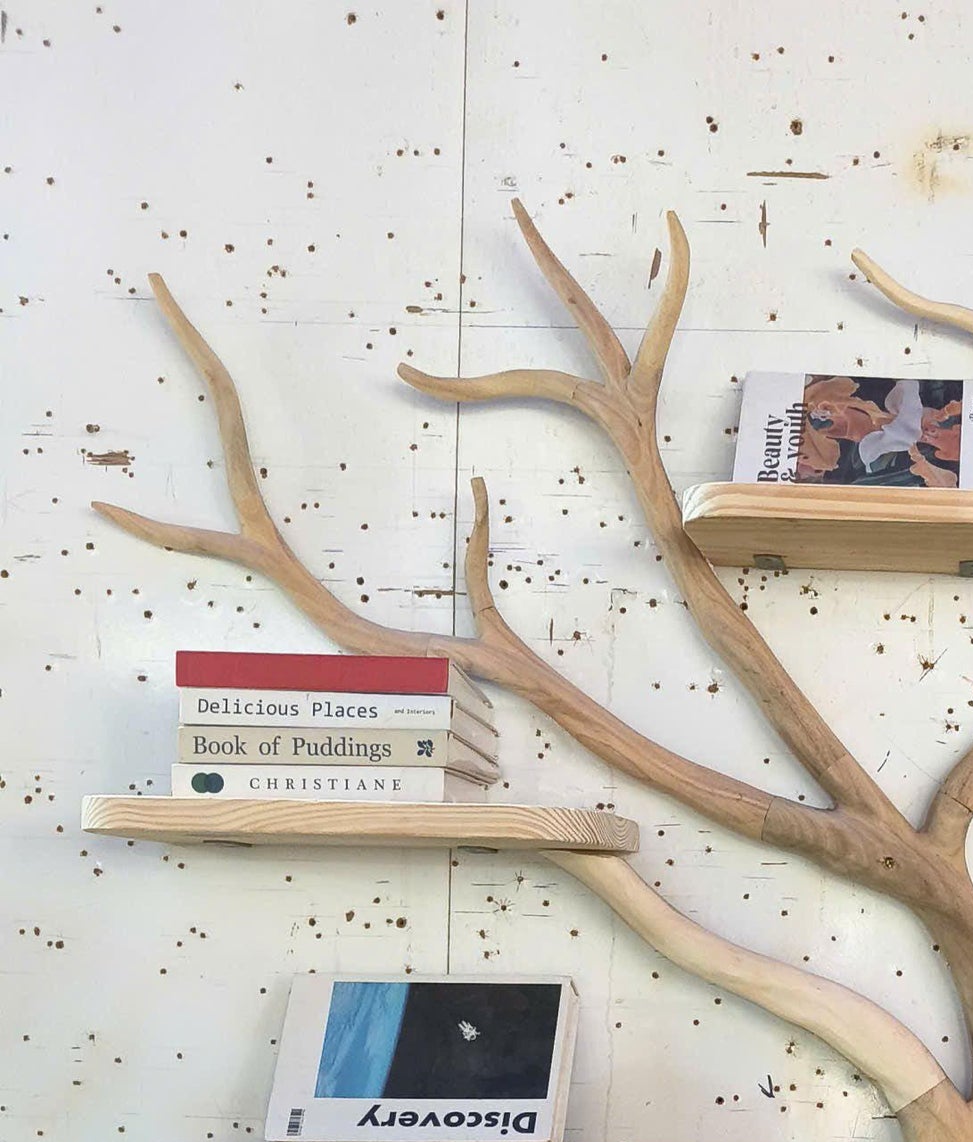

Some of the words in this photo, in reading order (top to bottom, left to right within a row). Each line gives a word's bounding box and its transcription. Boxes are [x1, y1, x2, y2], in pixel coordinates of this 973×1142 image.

[785, 402, 808, 460] youth
[757, 414, 789, 482] Beauty
[780, 467, 799, 483] &
[197, 698, 299, 716] Delicious
[312, 701, 378, 719] Places
[193, 735, 247, 756] Book
[259, 736, 281, 756] of
[292, 737, 392, 761] Puddings
[250, 777, 402, 791] CHRISTIANE
[357, 1104, 538, 1135] Discovery
